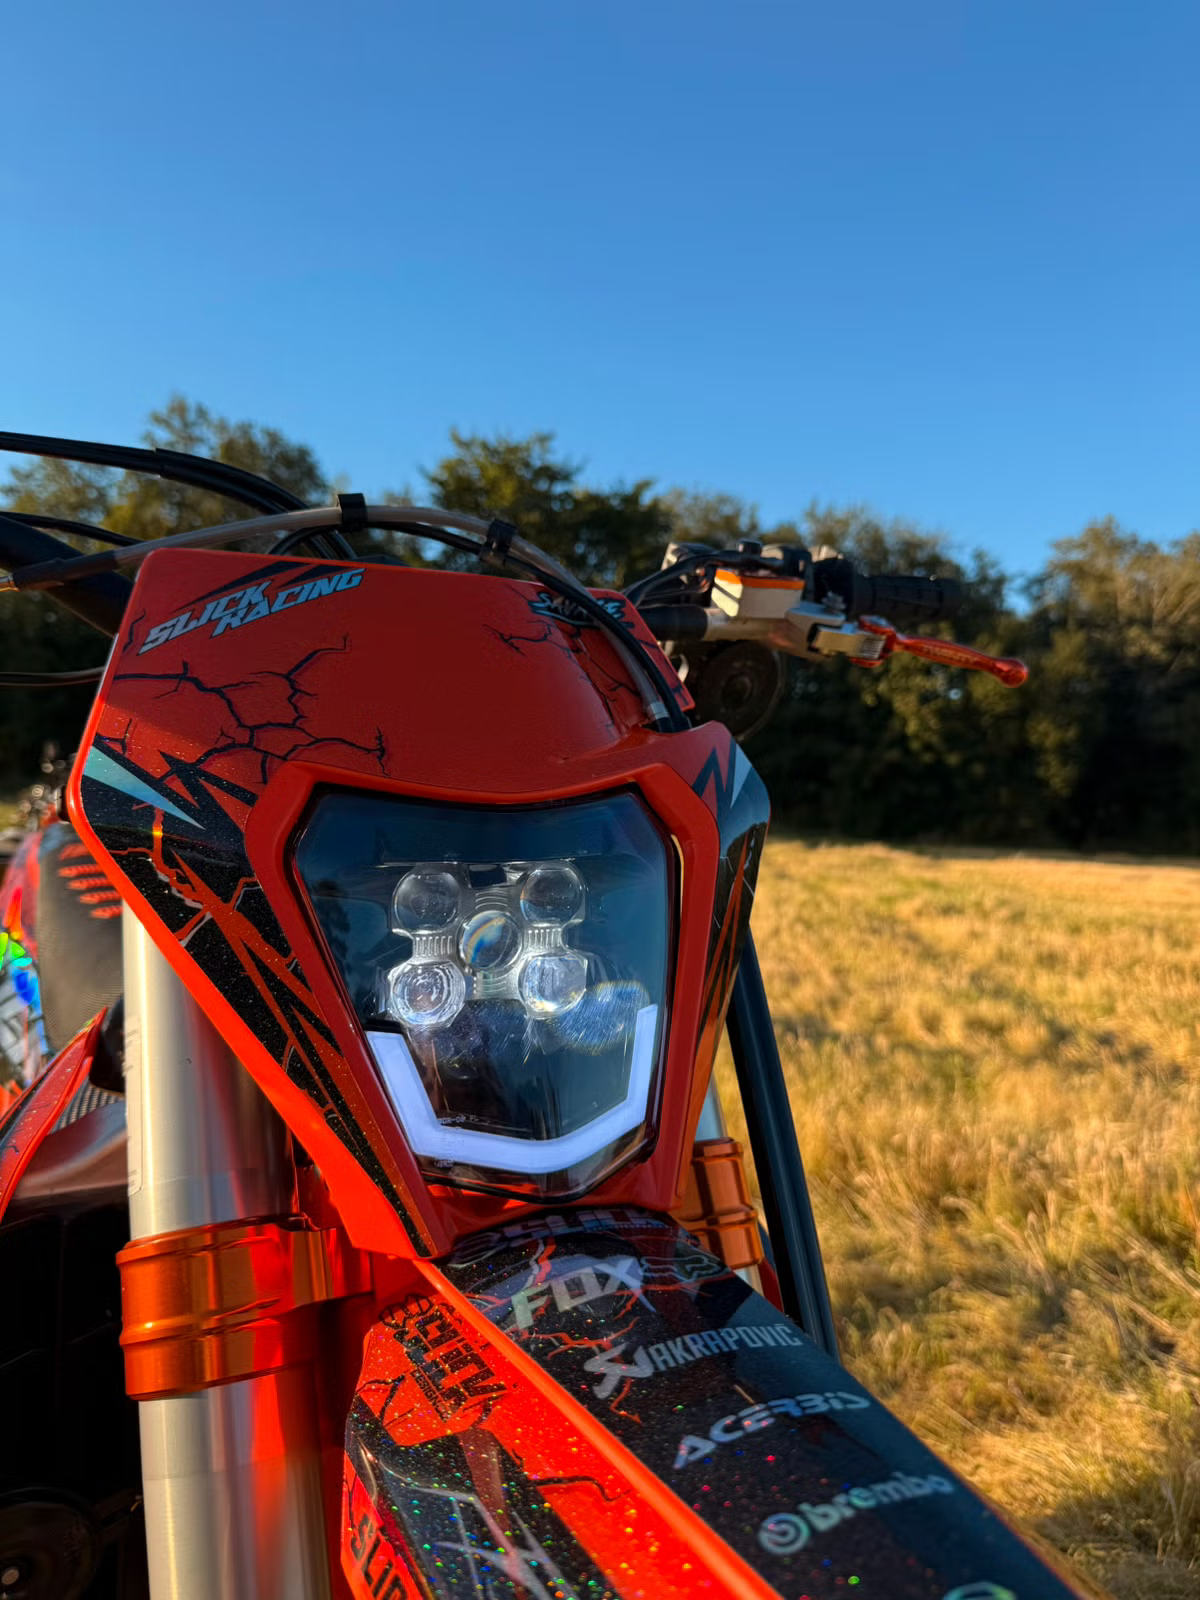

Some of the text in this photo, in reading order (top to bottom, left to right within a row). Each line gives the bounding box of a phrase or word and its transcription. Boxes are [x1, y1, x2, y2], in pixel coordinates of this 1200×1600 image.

[136, 580, 273, 656] SLICK
[209, 568, 366, 638] RACING
[511, 1257, 656, 1330] FOX
[797, 1471, 954, 1533] brembo
